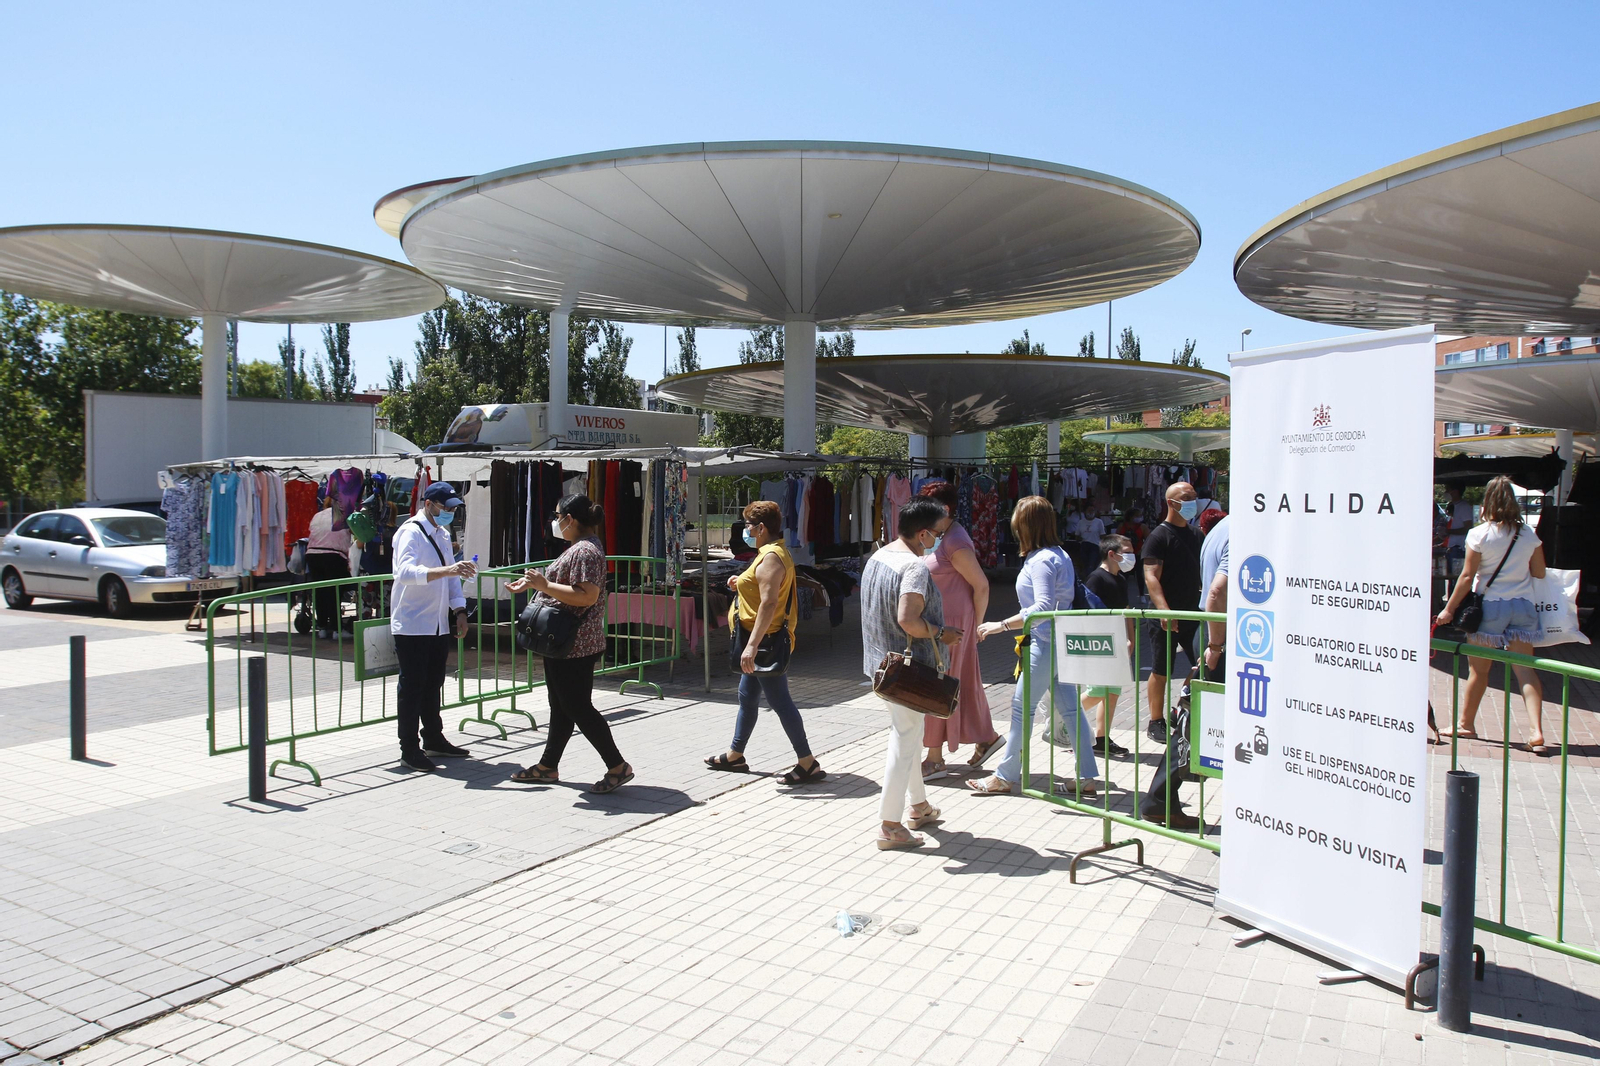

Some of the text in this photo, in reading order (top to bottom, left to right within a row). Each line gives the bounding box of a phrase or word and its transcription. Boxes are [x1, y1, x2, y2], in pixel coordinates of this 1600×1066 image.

[574, 415, 625, 430] VIVEROS
[588, 431, 627, 444] BARBARA
[1281, 432, 1325, 444] AYUNTAMIENTO
[1326, 432, 1333, 442] DE
[1289, 443, 1356, 456] Delegación de Comercio
[1253, 492, 1395, 515] SALIDA
[1286, 576, 1421, 599] MANTENGA LA DISTANCIA
[1311, 594, 1390, 612] DE SEGURIDAD
[1534, 601, 1559, 613] ties
[1067, 639, 1112, 652] SALIDA
[1286, 633, 1417, 662] OBLIGATORIO EL USO DE
[1314, 653, 1383, 674] MASCARILLA
[1285, 698, 1415, 733] UTILICE LAS PAPELERAS
[1207, 727, 1225, 739] AYUN
[1209, 760, 1223, 768] PER
[1283, 746, 1416, 788] USE EL DISPENSADOR DE
[1285, 761, 1412, 804] GEL HIDROALCOHÓLICO
[1235, 806, 1408, 873] GRACIAS POR SU VISITA
